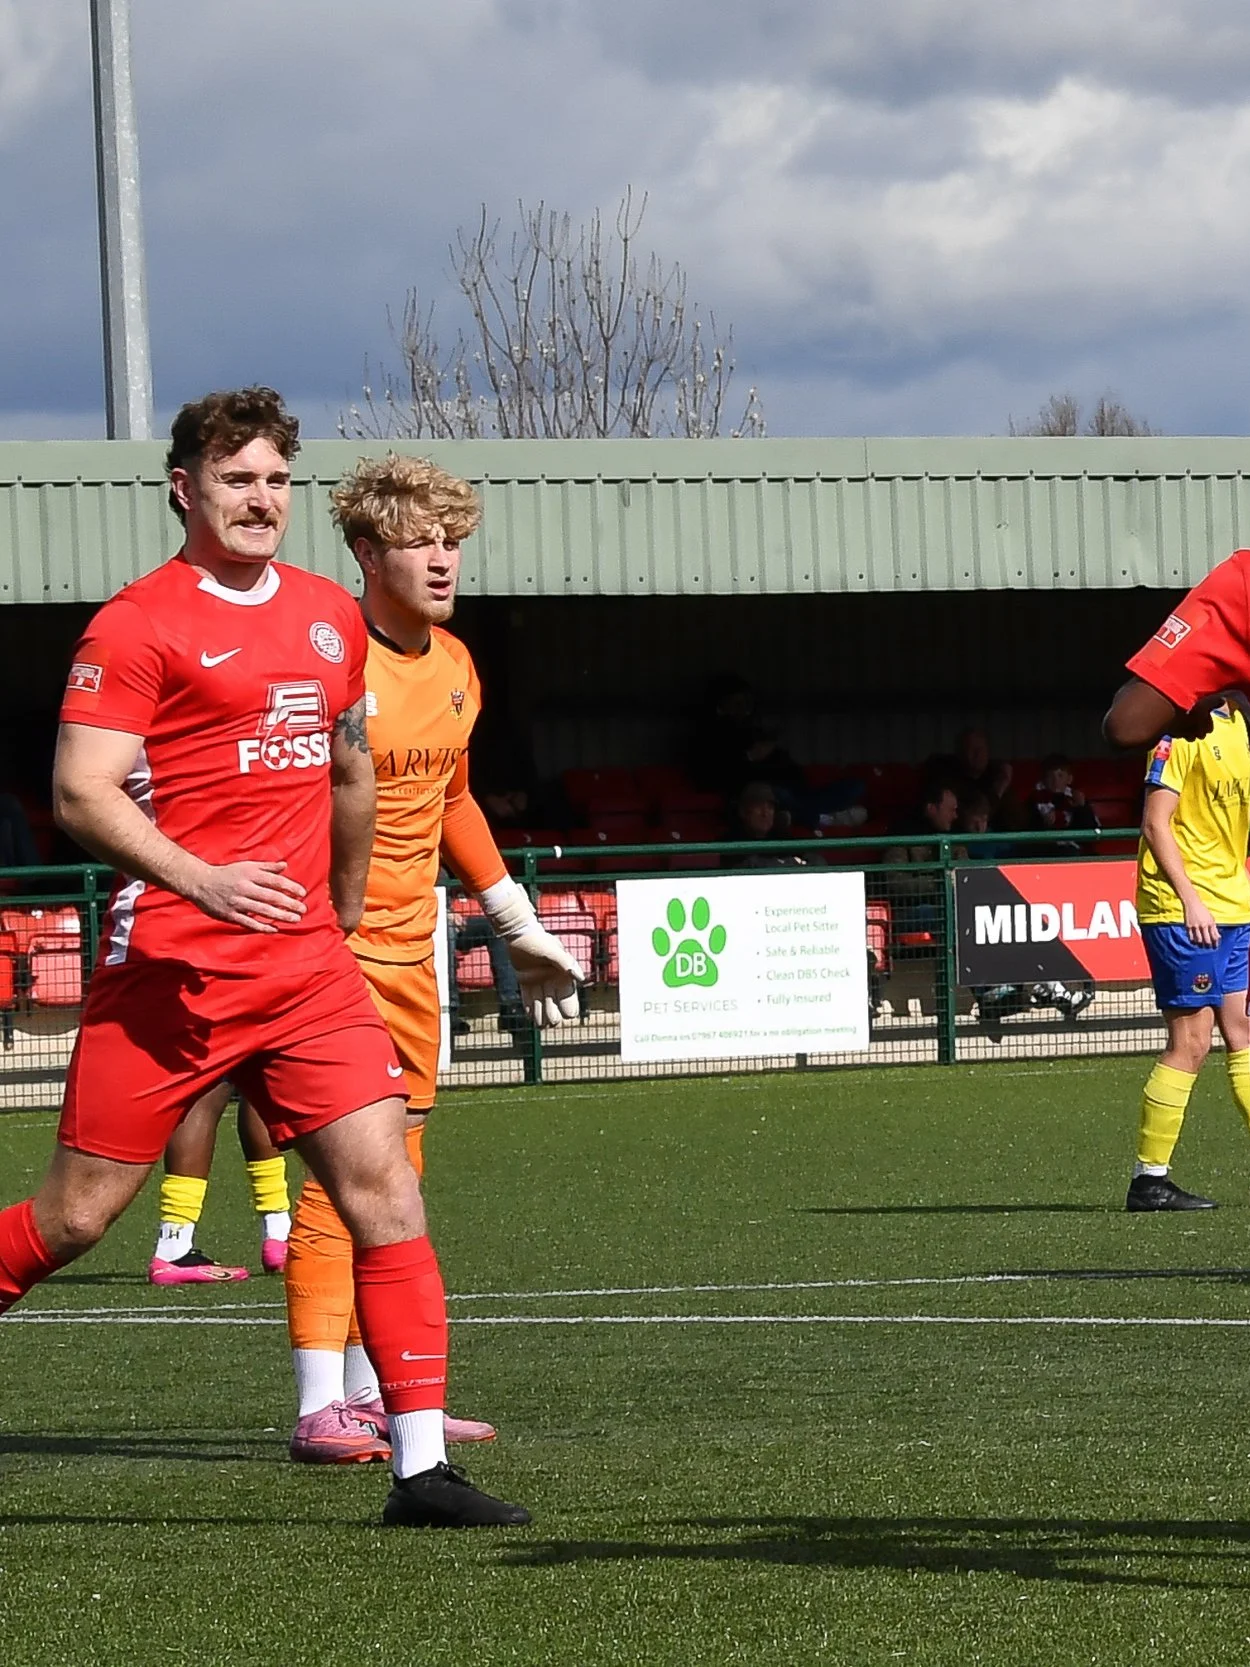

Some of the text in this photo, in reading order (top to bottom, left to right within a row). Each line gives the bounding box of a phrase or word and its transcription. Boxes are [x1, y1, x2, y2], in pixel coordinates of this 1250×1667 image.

[765, 905, 827, 918] Experienced
[765, 921, 839, 934] Local Pet Sitter
[766, 945, 839, 958] Safe & Reliable
[675, 952, 707, 977] DB
[767, 969, 794, 980] Clean
[820, 967, 850, 979] Check
[767, 993, 831, 1006] Fully Insured
[643, 999, 738, 1014] PET SERVICES
